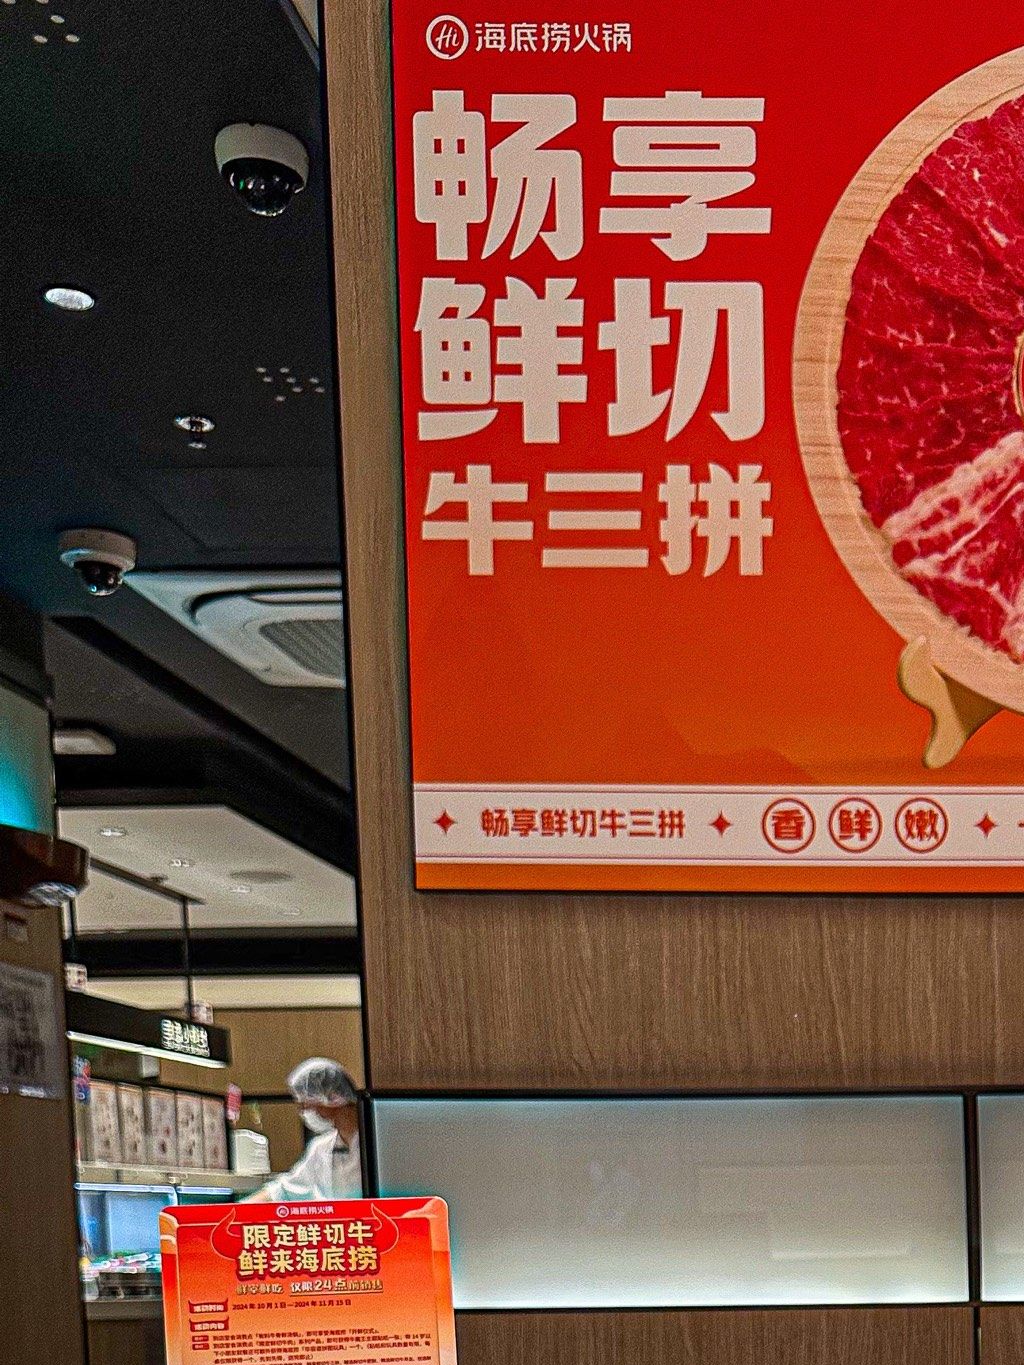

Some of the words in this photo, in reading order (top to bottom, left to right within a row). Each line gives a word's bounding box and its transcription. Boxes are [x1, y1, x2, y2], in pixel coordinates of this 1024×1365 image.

[475, 22, 632, 54] 海底捞火锅
[413, 90, 771, 261] 畅享
[413, 277, 765, 444] 鲜切
[421, 464, 774, 578] 牛三拼
[481, 808, 686, 839] 畅享鲜切牛三拼
[770, 809, 804, 842] 香
[838, 808, 874, 843] 鲜
[904, 809, 939, 843] 嫩
[243, 1221, 373, 1249] 限定鲜切牛
[238, 1245, 378, 1276] 鲜来海底捞
